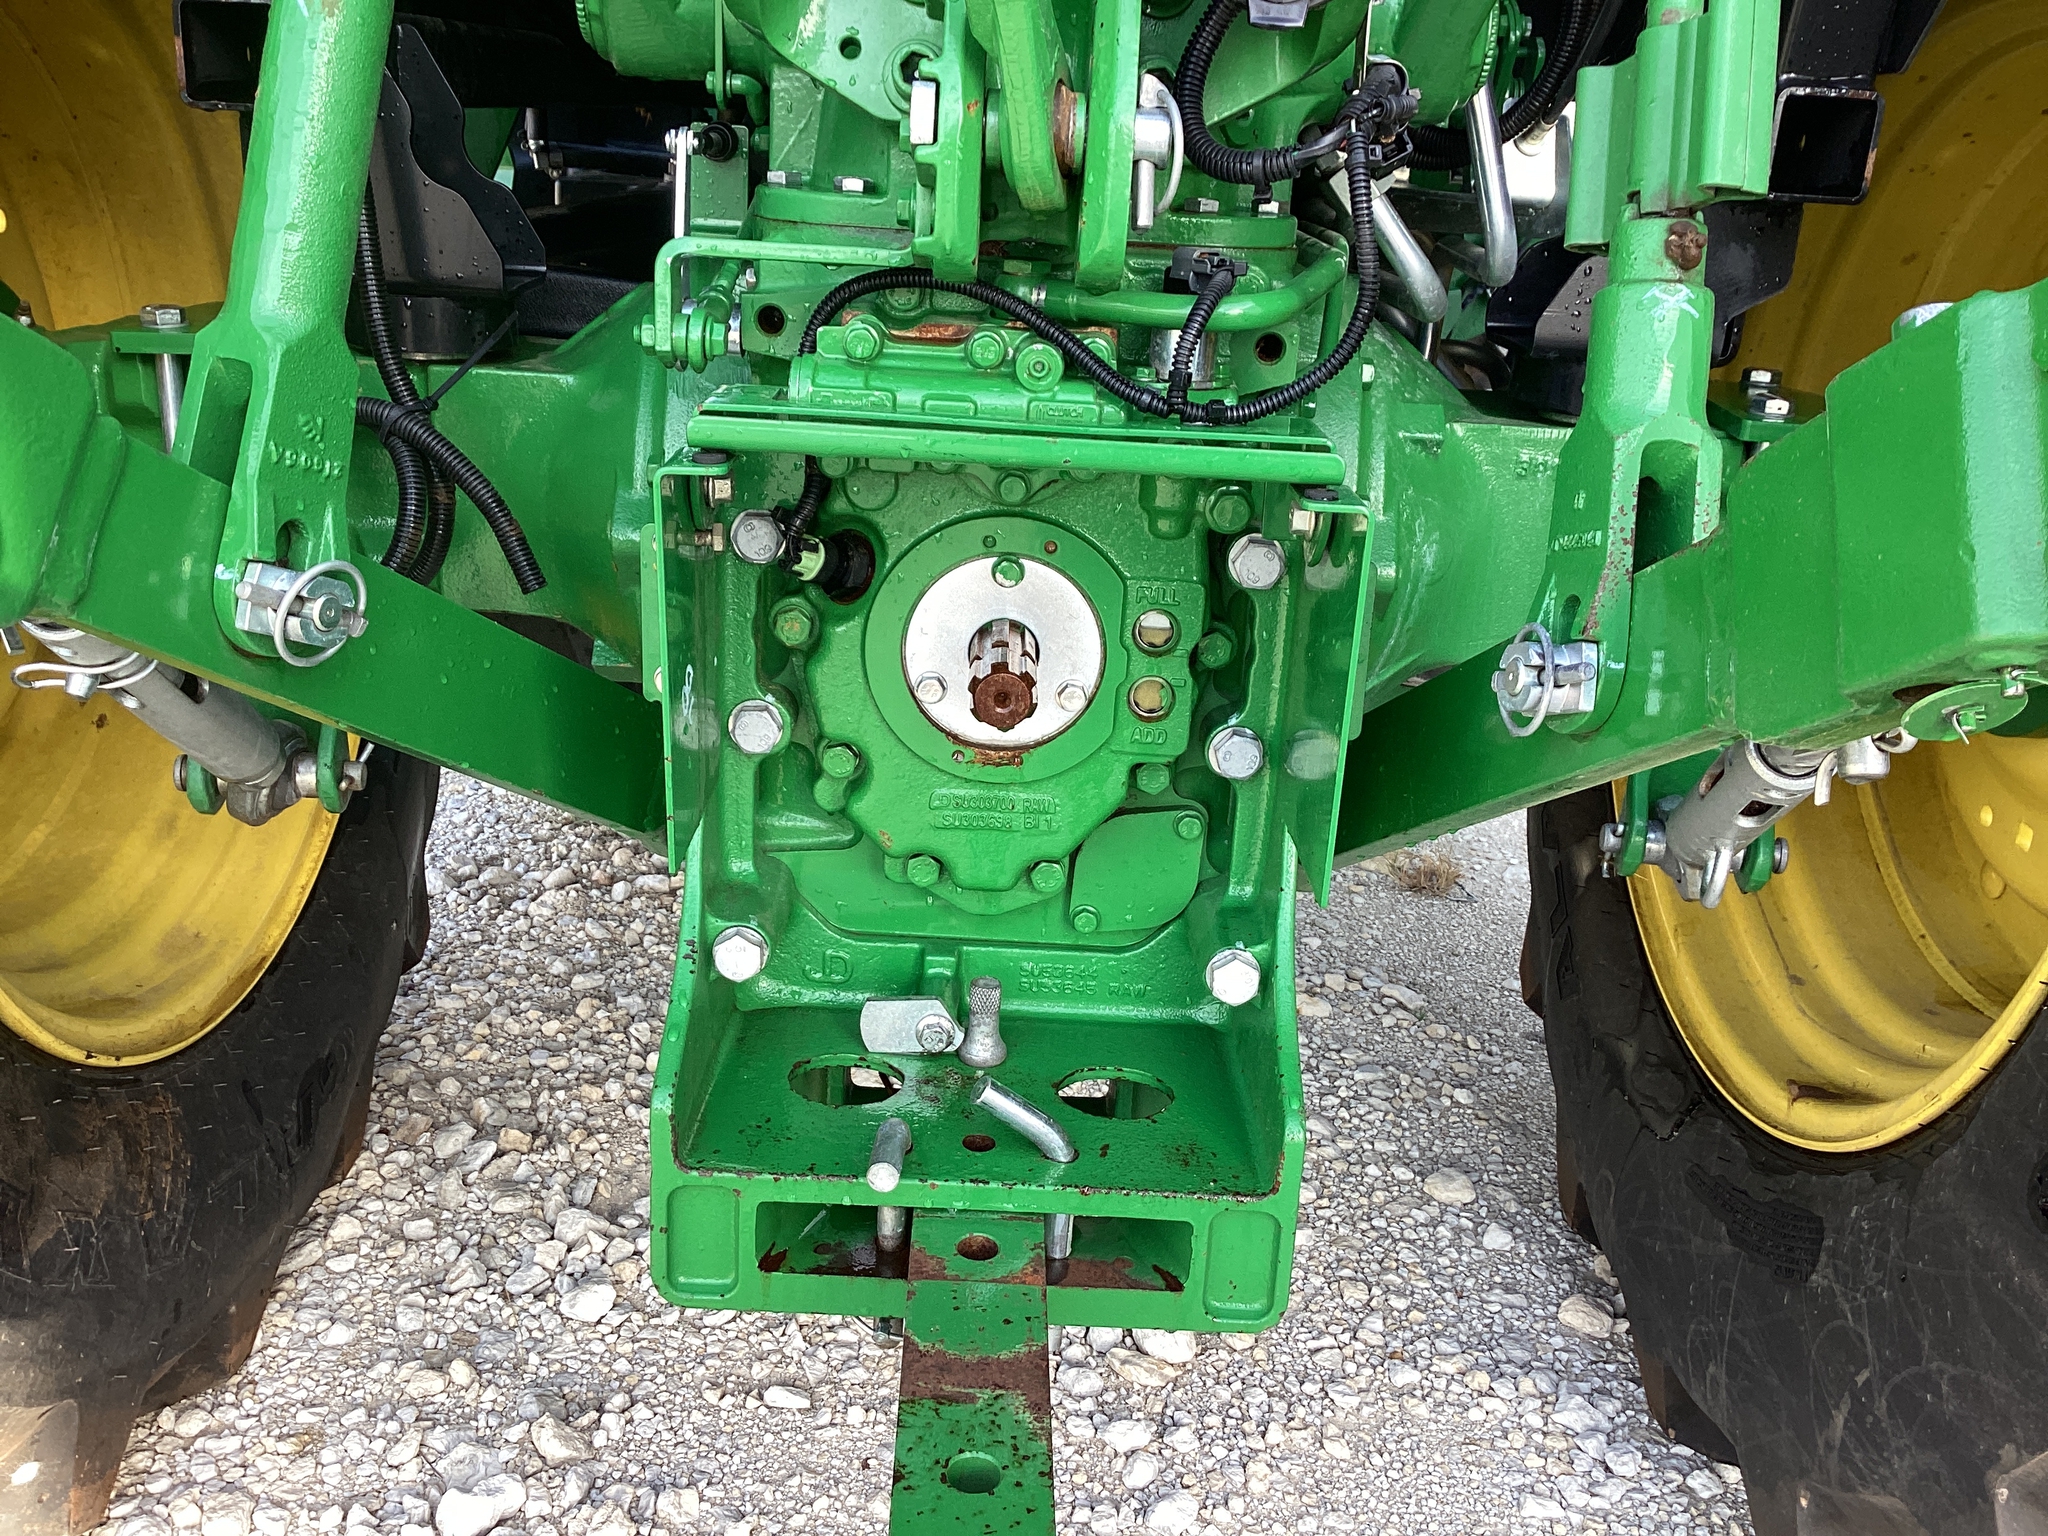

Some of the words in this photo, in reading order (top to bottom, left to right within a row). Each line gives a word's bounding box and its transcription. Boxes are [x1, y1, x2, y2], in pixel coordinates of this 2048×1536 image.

[1136, 586, 1181, 606] FULL
[1130, 726, 1168, 745] ADD
[1023, 798, 1052, 813] RAW
[942, 813, 1013, 829] SU303698
[1108, 983, 1152, 998] RAW
